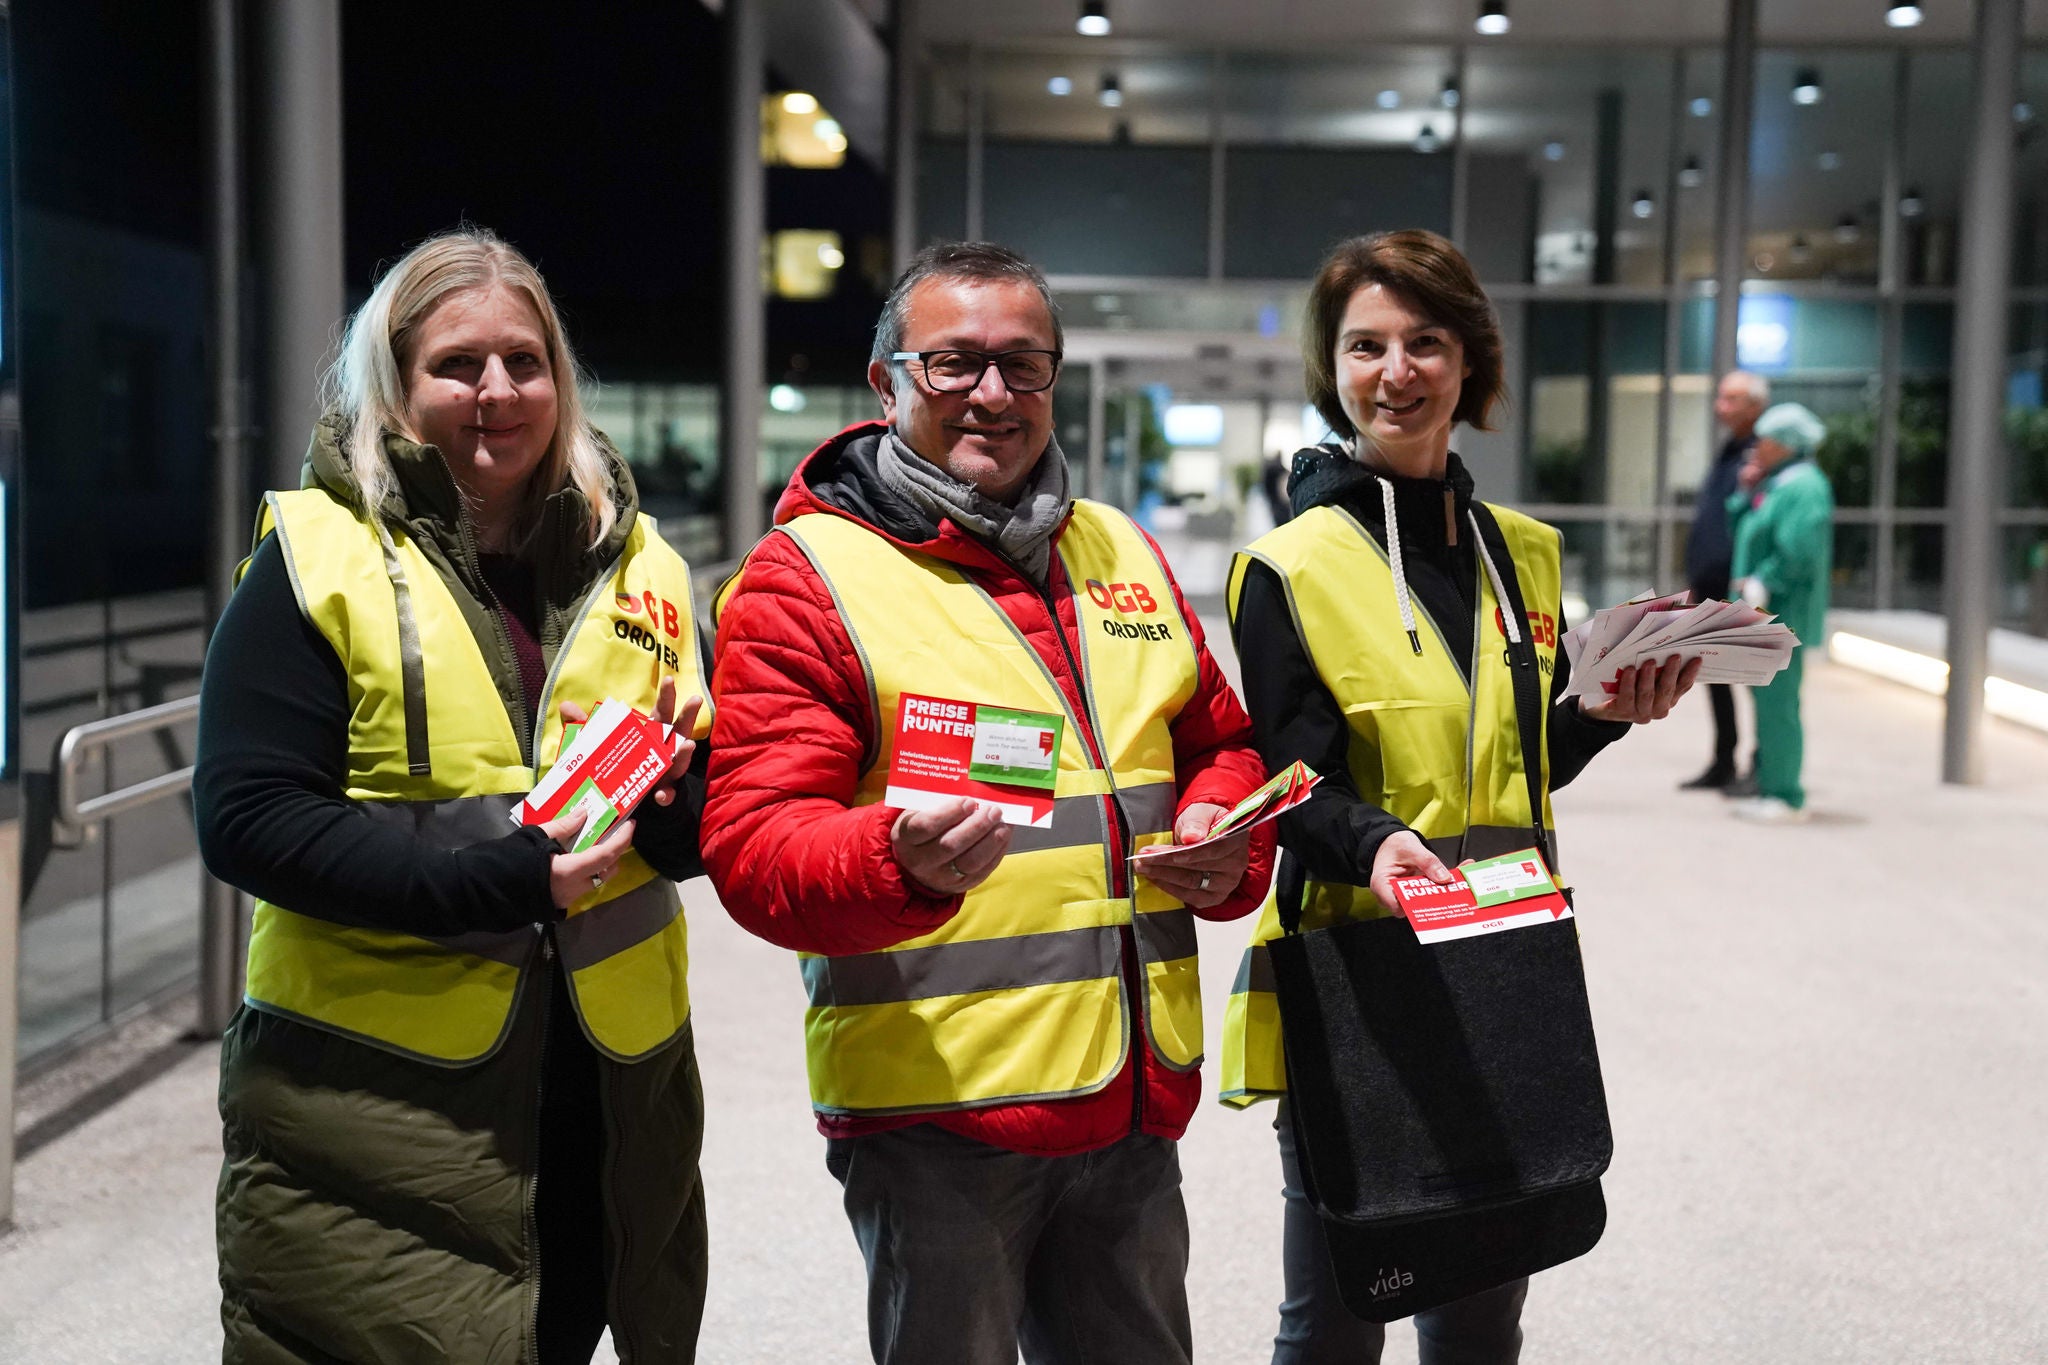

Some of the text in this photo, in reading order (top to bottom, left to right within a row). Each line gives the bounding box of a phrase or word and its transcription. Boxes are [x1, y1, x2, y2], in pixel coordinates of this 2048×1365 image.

[1085, 578, 1158, 614] OGB
[1103, 619, 1173, 641] ORDNER
[904, 698, 969, 720] PREISE
[902, 714, 976, 738] RUNTER
[566, 753, 583, 772] OGB
[608, 747, 660, 807] RUNTER
[620, 757, 666, 809] PREISE
[1404, 881, 1470, 901] RUNTER
[1482, 920, 1505, 929] OGB
